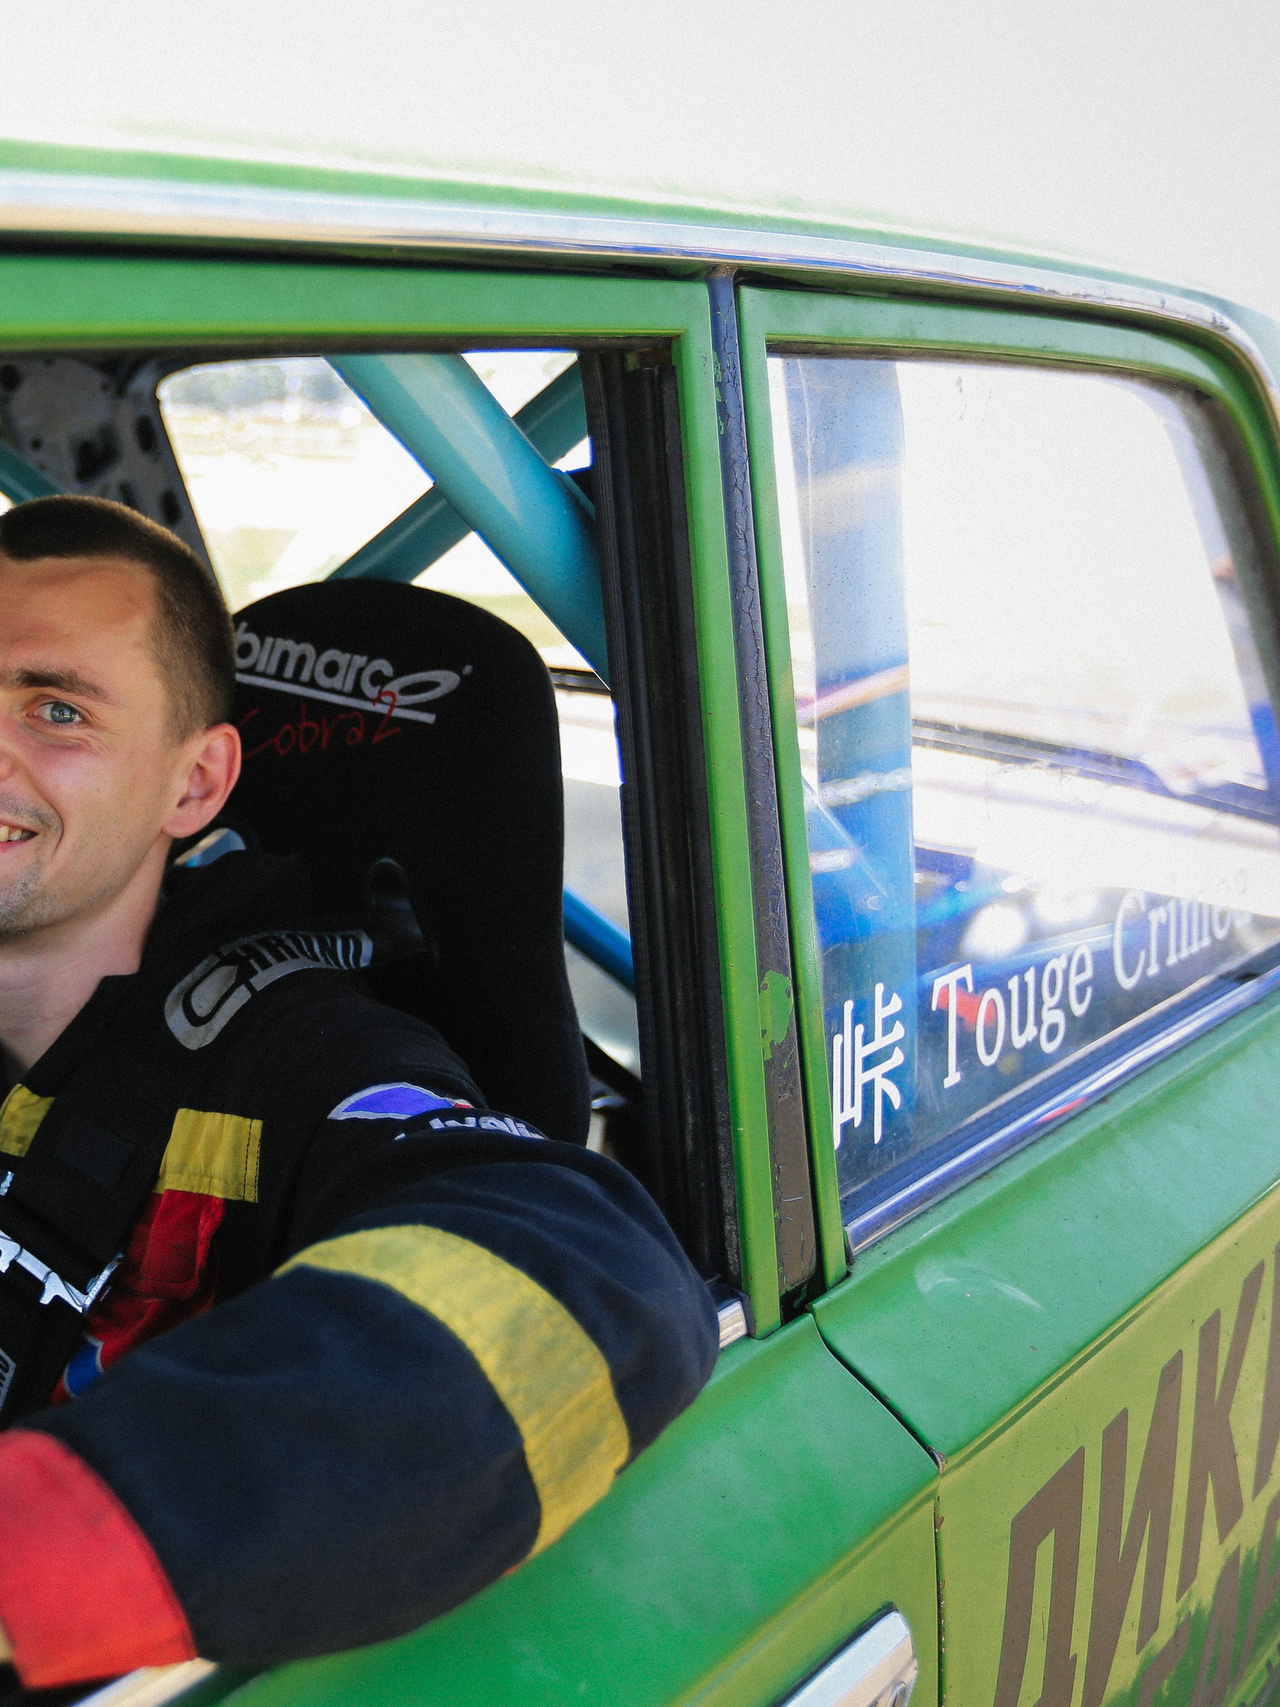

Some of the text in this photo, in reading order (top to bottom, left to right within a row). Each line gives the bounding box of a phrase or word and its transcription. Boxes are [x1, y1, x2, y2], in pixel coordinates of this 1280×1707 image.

[236, 621, 462, 706] bimarco
[832, 982, 905, 1150] 峠
[931, 945, 1094, 1089] Touge
